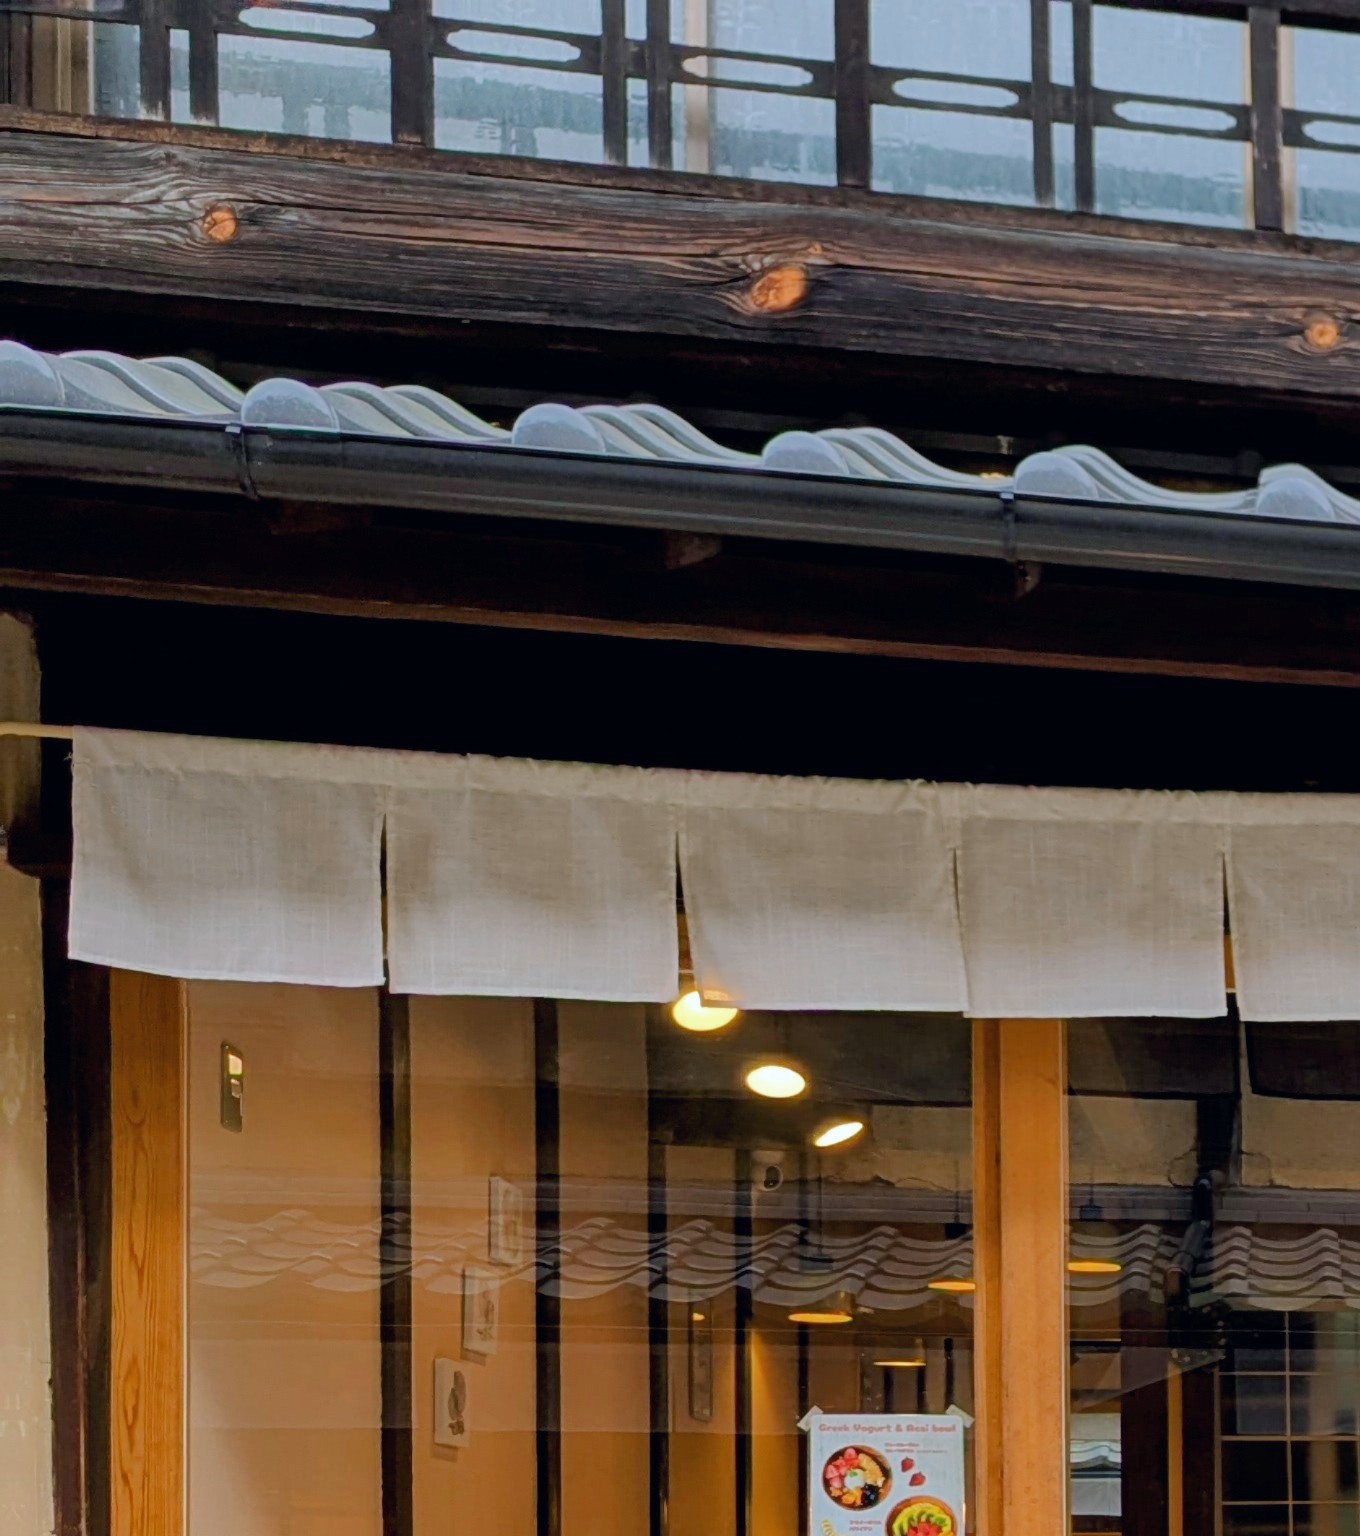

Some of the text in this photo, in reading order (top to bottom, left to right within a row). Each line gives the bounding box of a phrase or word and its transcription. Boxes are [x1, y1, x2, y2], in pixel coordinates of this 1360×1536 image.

[819, 1424, 849, 1432] Greek
[853, 1424, 892, 1434] Yogurt
[932, 1424, 956, 1432] bowl
